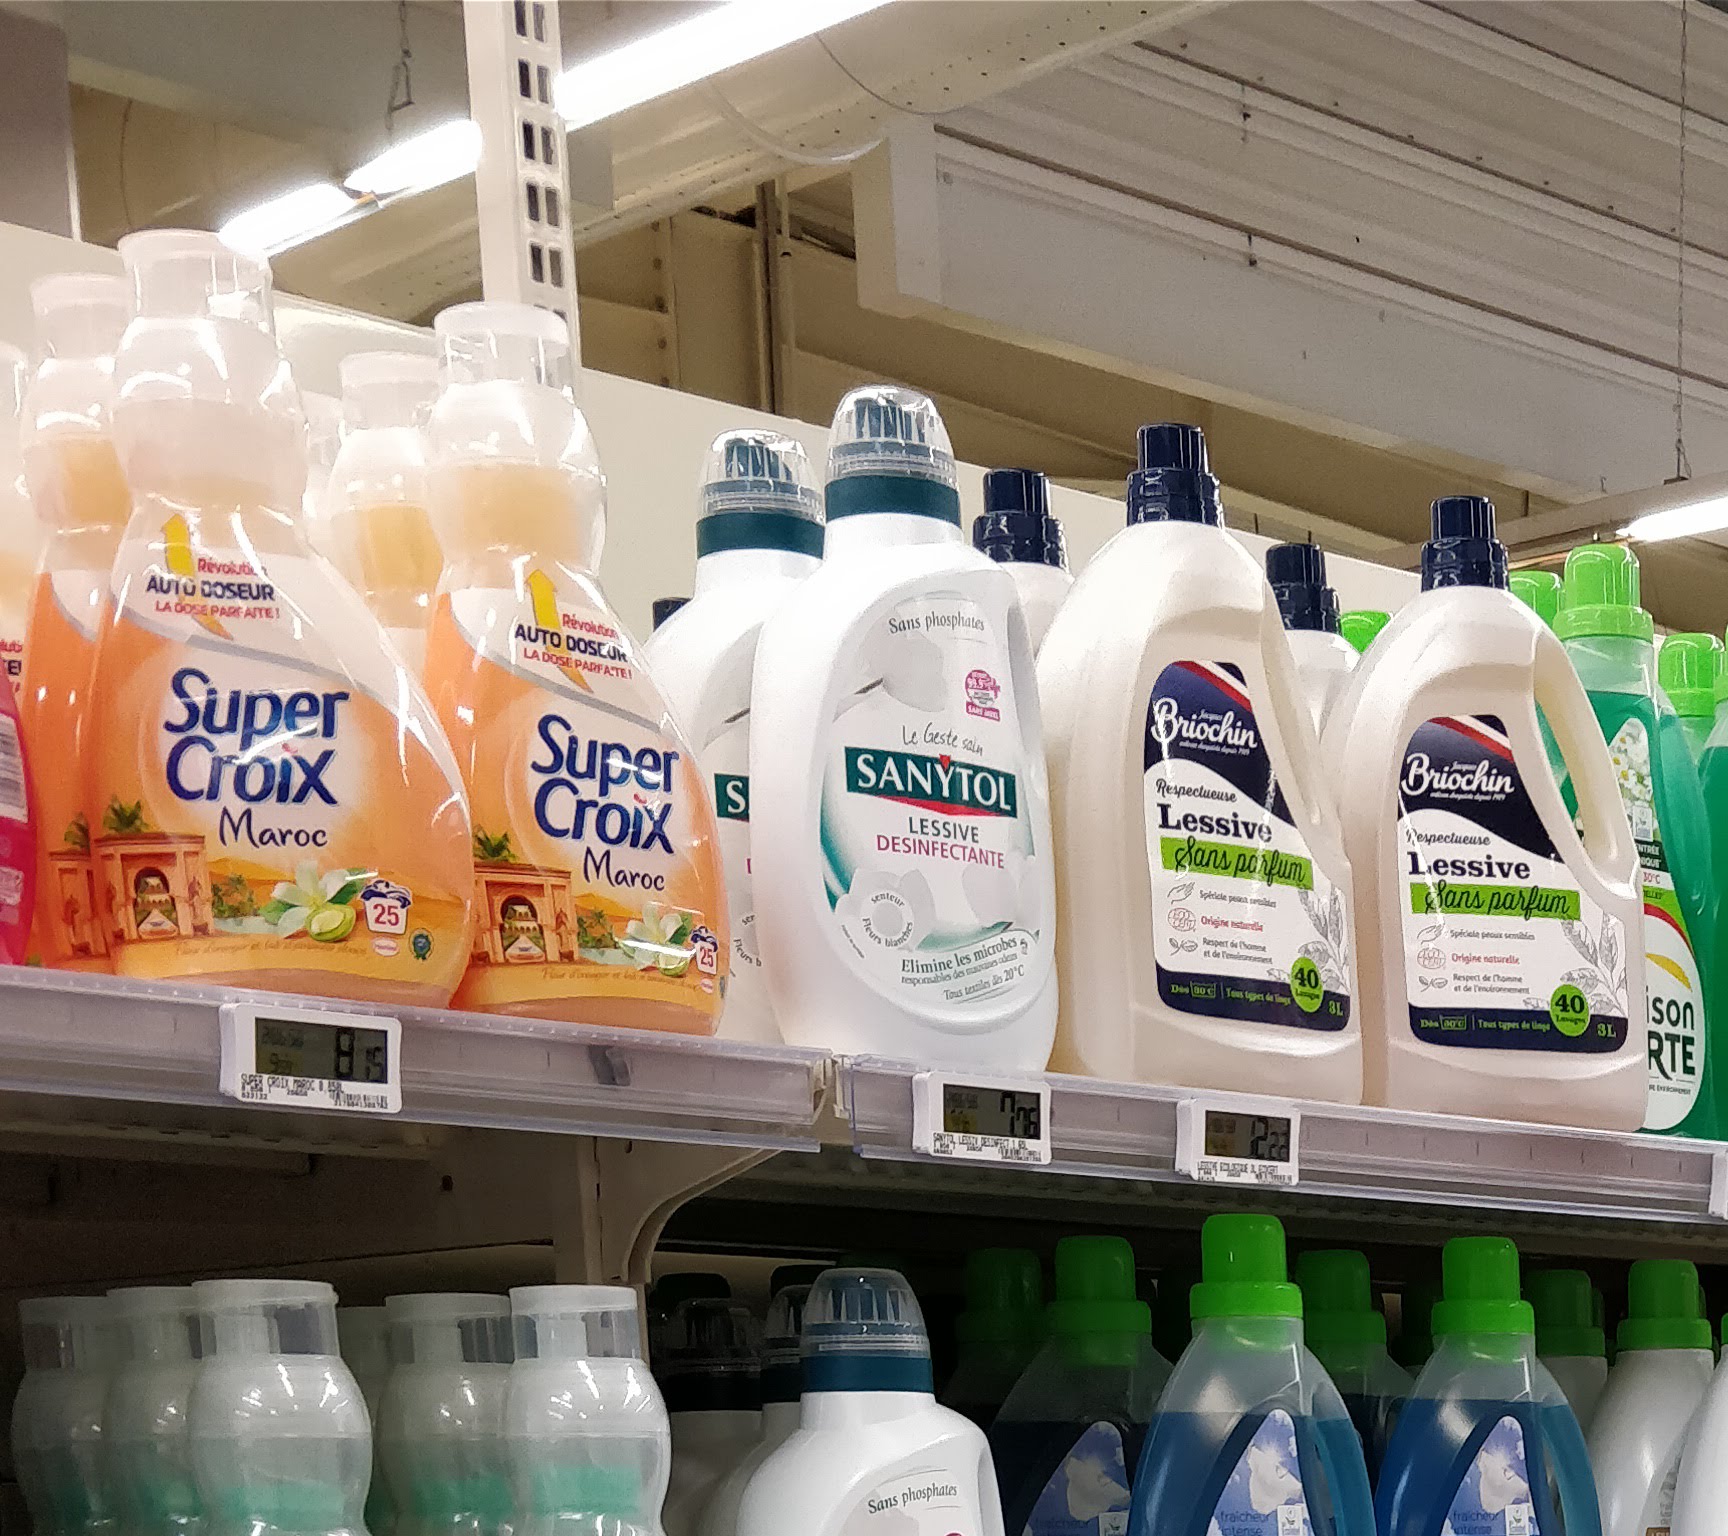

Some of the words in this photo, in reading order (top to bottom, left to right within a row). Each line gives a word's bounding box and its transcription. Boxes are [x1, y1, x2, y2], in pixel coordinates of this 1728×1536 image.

[888, 616, 921, 634] Sans
[926, 612, 985, 634] phosphates
[164, 668, 350, 741] Super
[924, 723, 958, 748] Geste
[1152, 697, 1257, 751] Briochin
[165, 734, 338, 806] Croix
[856, 755, 1012, 811] SANYTOL
[1401, 752, 1515, 795] Briochin
[1156, 779, 1237, 803] Respectueuse
[219, 806, 328, 848] Maroc
[909, 816, 979, 843] LESSIVE
[1159, 803, 1272, 843] Lessive
[876, 834, 1005, 869] DESINFECTANTE
[1175, 836, 1232, 870] Sans
[1233, 849, 1305, 884] parfum
[1409, 852, 1530, 880] Lessive
[582, 847, 665, 892] Maroc
[373, 904, 399, 926] 25
[1426, 882, 1484, 910] Sans
[1488, 891, 1570, 916] parfum
[699, 946, 714, 969] 25
[902, 955, 949, 974] Elimine
[953, 949, 970, 968] les
[973, 937, 1018, 963] microbes
[1452, 952, 1480, 966] Origine
[1484, 954, 1520, 965] naturelle
[1555, 996, 1585, 1016] 40
[868, 1489, 899, 1514] Sans
[902, 1483, 958, 1508] phosphates
